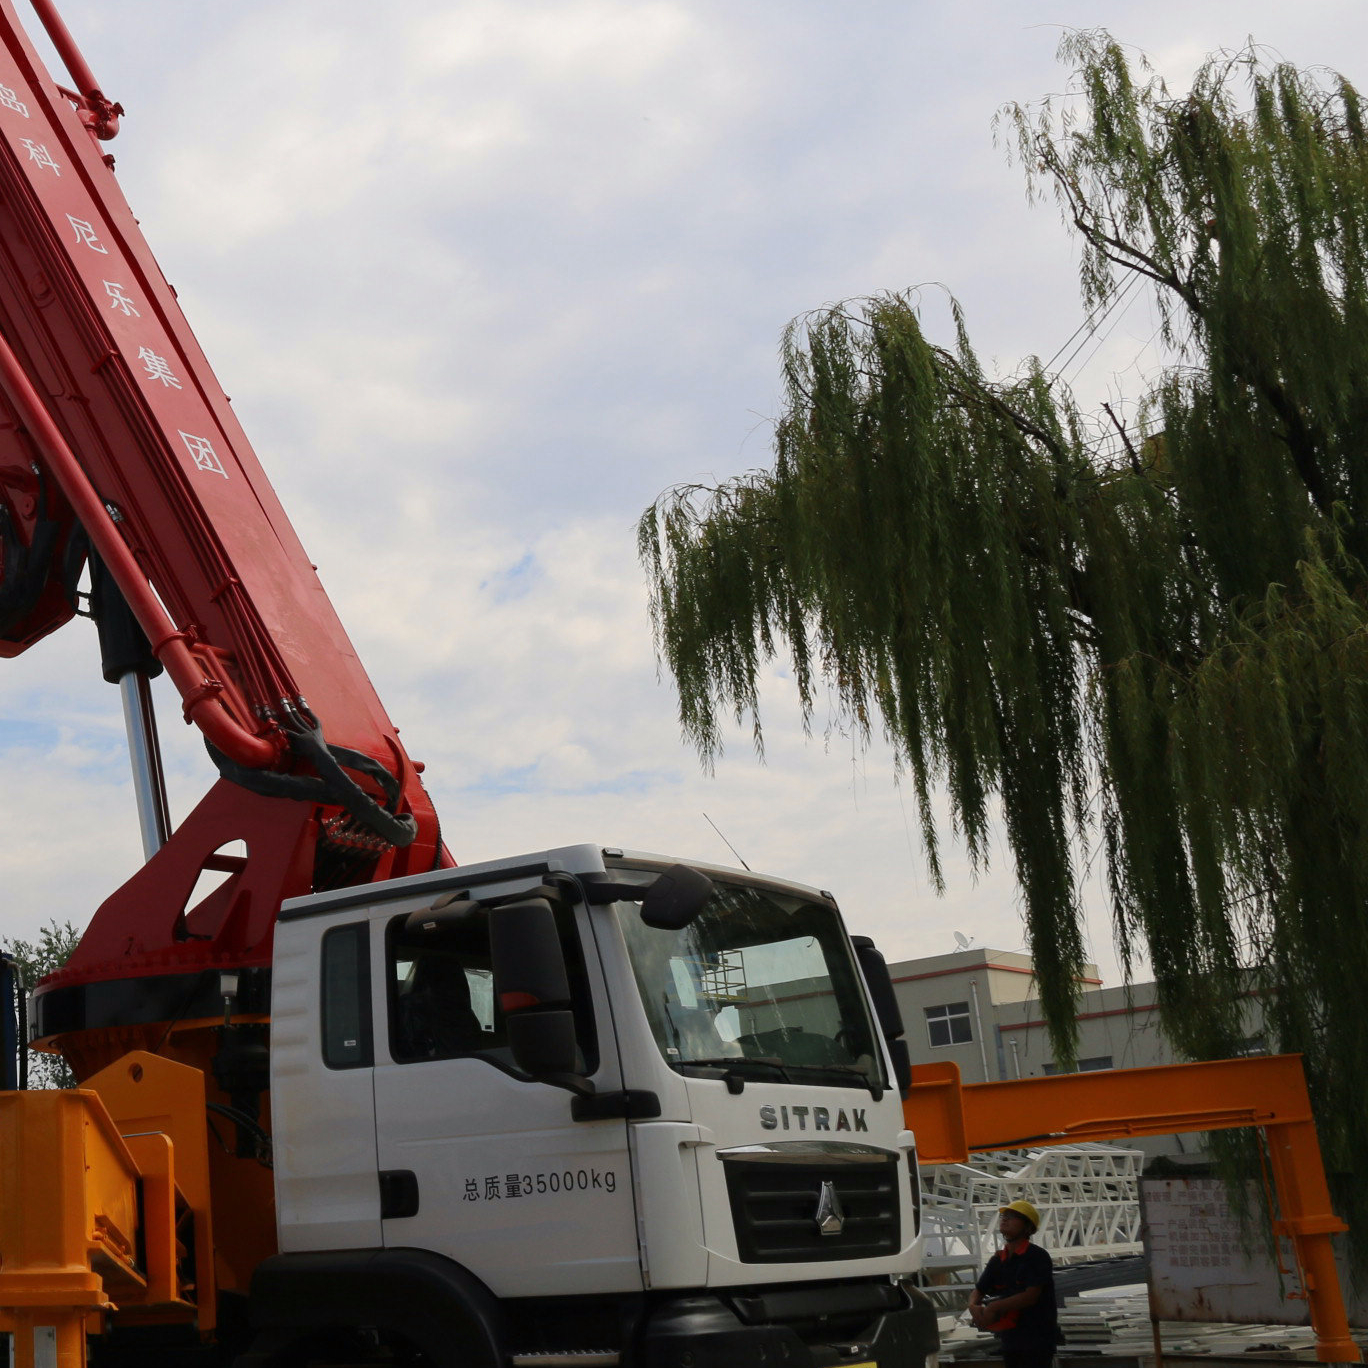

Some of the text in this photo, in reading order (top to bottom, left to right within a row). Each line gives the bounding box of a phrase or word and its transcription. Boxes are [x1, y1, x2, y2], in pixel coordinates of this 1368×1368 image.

[759, 1104, 868, 1132] SITRAK
[463, 1168, 616, 1201] 总质量35000kg
